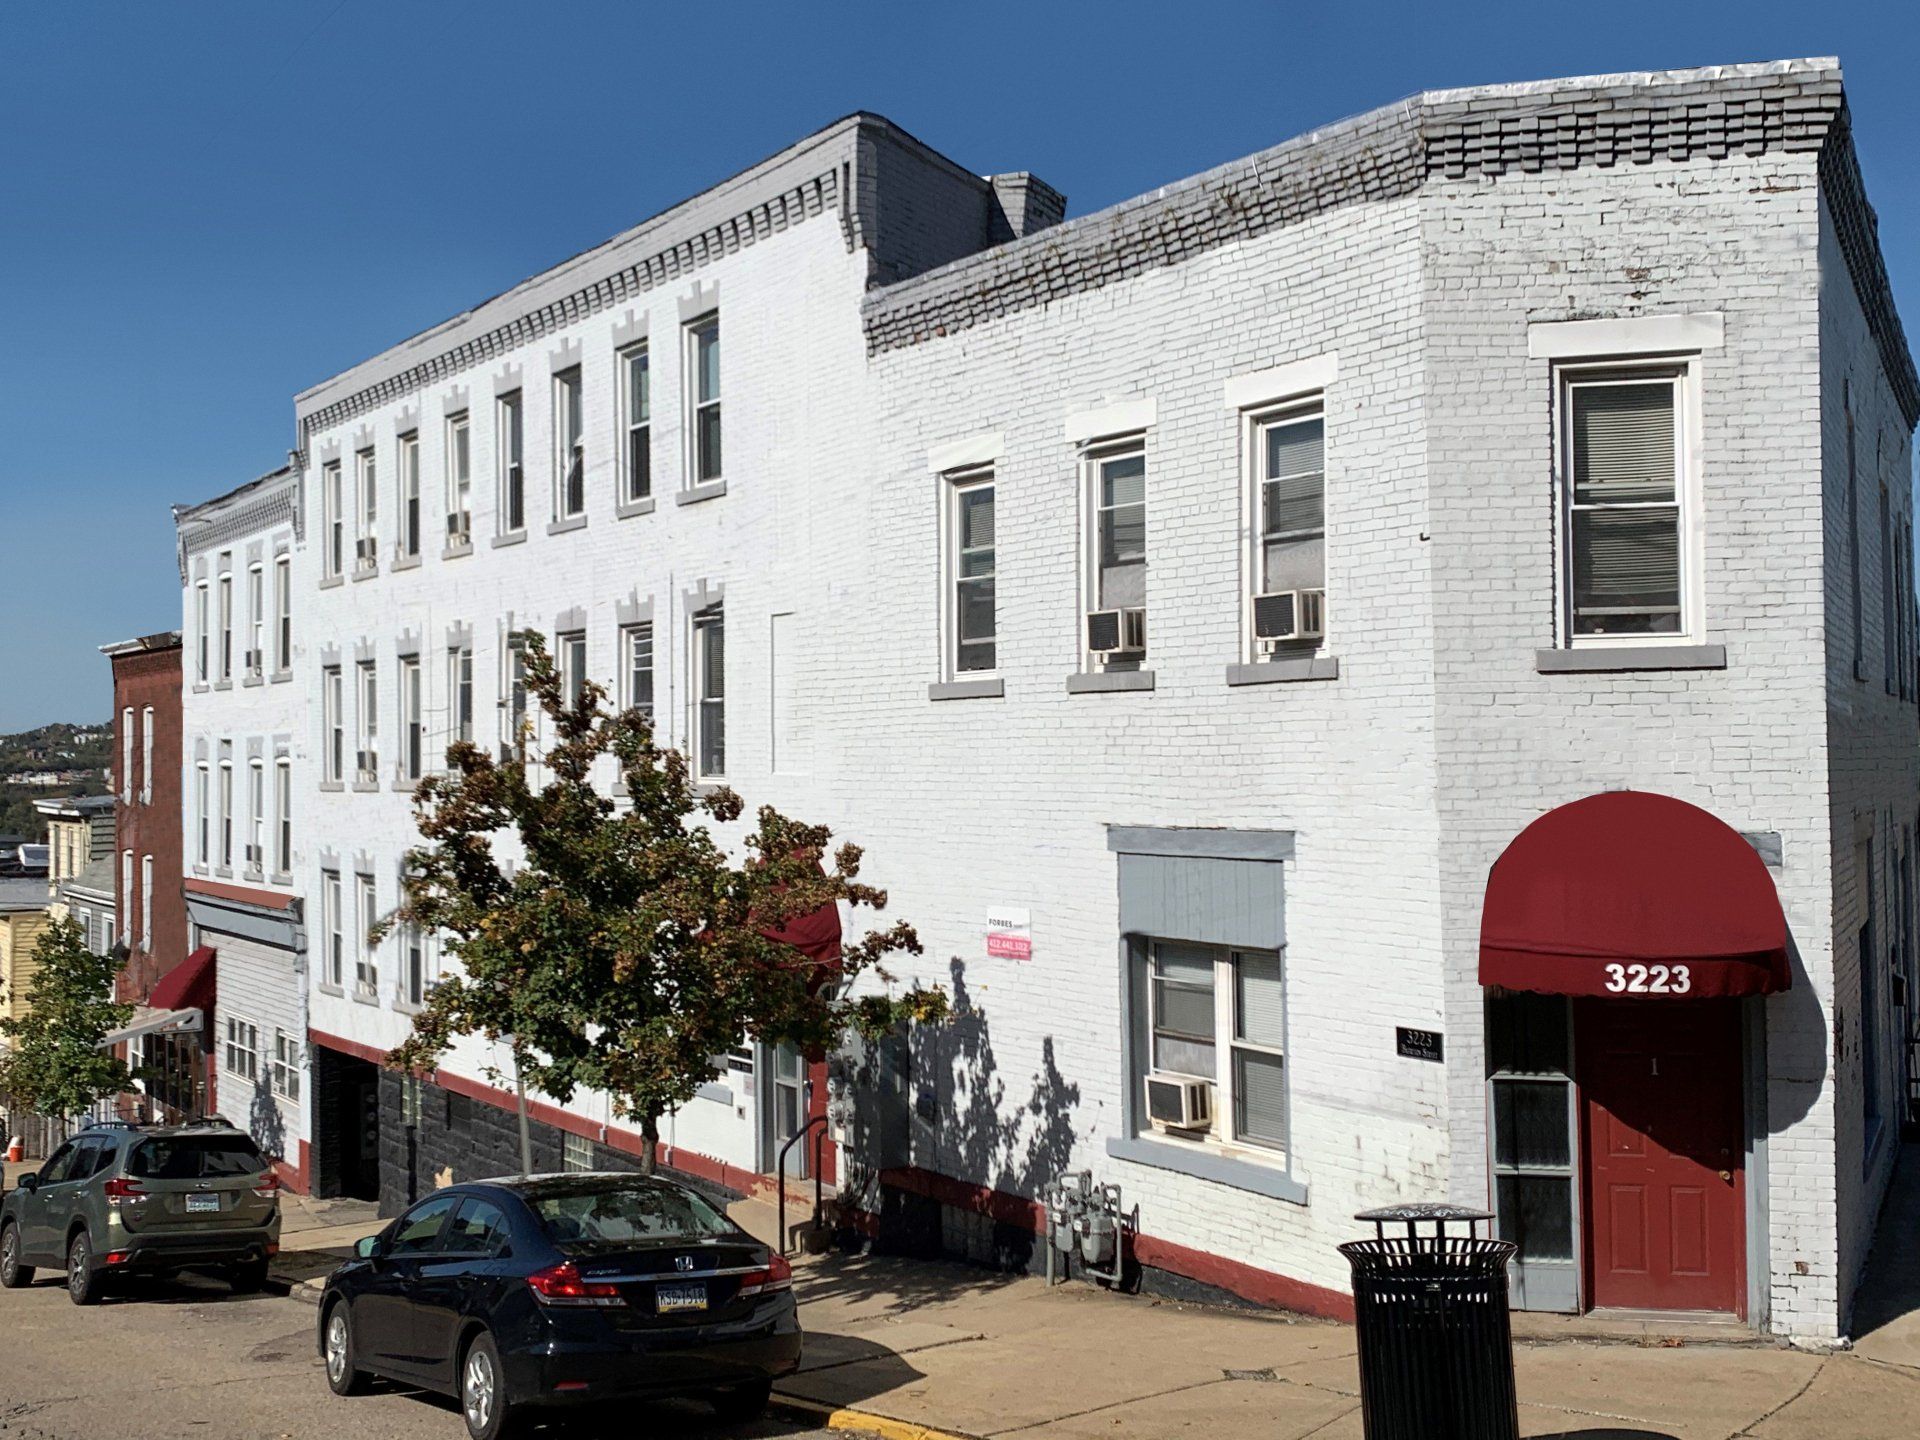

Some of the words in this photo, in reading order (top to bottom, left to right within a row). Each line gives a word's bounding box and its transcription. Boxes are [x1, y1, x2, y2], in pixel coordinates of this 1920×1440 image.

[988, 918, 1013, 928] FORBES
[1604, 963, 1691, 993] 3223
[1406, 1029, 1432, 1048] 3223
